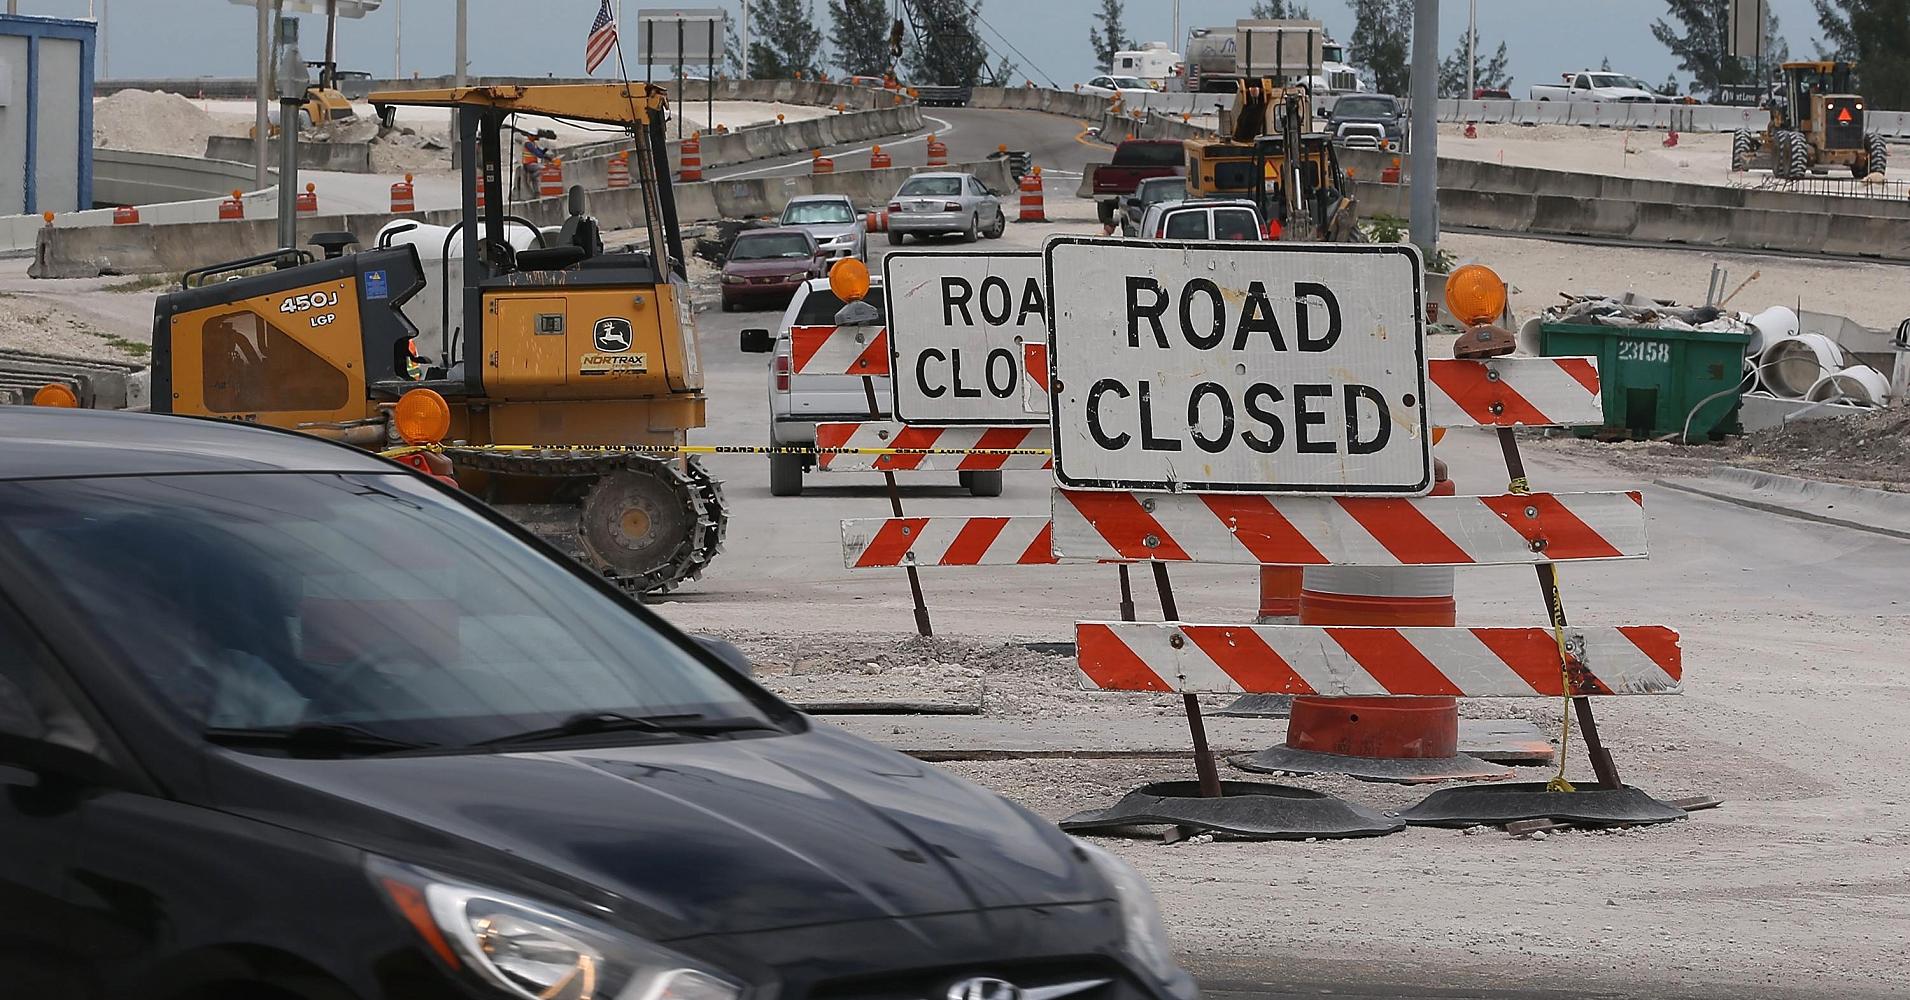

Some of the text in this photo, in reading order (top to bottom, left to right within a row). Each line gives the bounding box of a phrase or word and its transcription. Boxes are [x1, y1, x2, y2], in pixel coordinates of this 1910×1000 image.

[1729, 91, 1743, 102] Nxt
[280, 292, 338, 313] 450J
[941, 276, 1046, 326] ROA
[310, 313, 336, 327] LGP
[1126, 276, 1342, 352] ROAD
[583, 356, 643, 365] NORTRAX
[1618, 341, 1670, 362] 23158
[916, 348, 1018, 398] CLO
[1086, 378, 1392, 455] CLOSED
